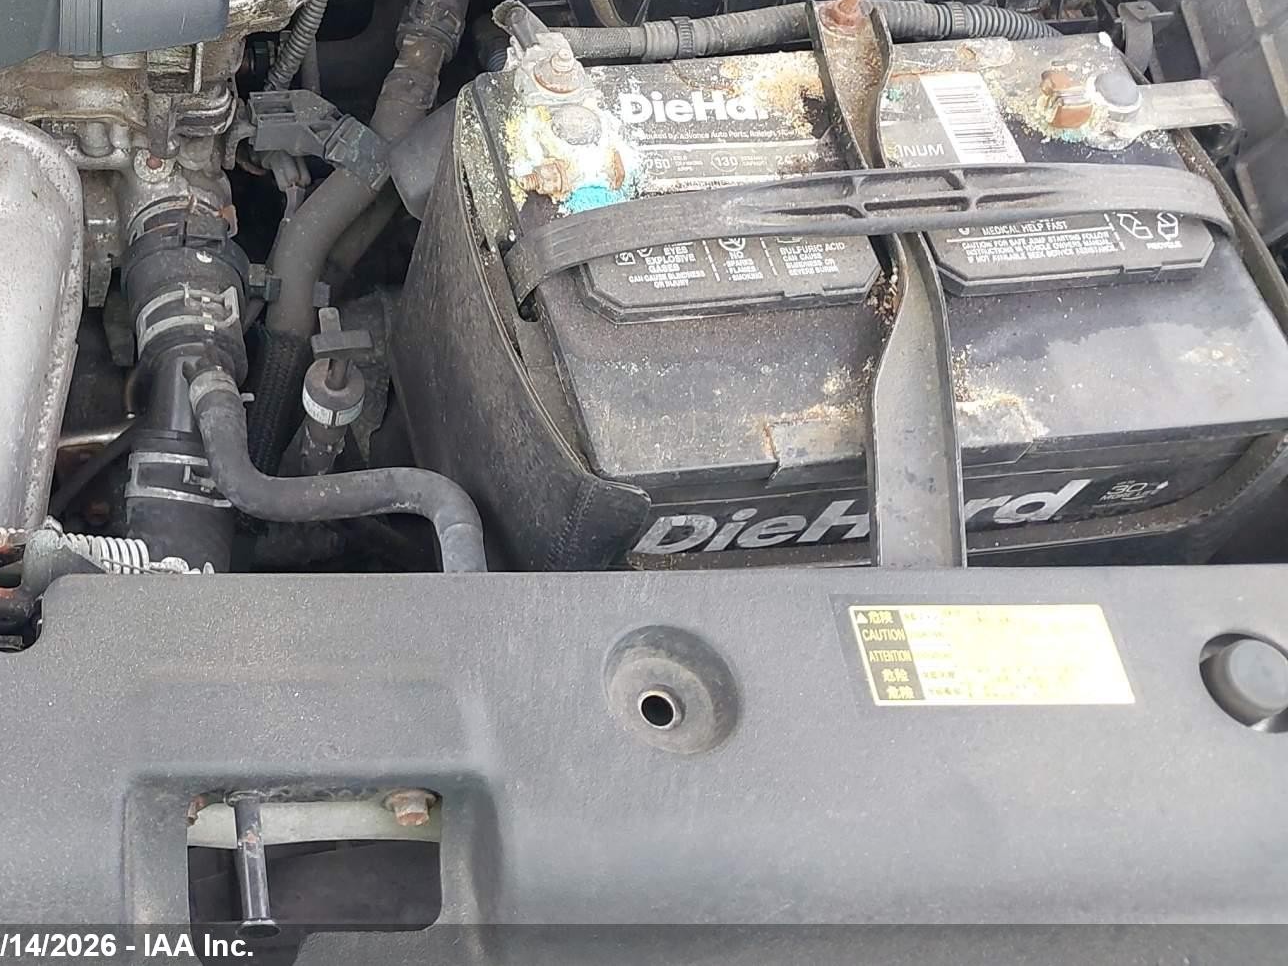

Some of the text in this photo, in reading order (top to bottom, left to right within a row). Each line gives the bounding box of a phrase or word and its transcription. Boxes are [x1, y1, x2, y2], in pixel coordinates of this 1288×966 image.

[981, 224, 1020, 236] MEDICAL
[1021, 222, 1044, 233] HELP
[1045, 220, 1068, 231] FAST
[663, 245, 689, 256] EYES
[779, 241, 846, 255] SULFURIC ACID
[645, 253, 697, 266] EXPLOSIVE
[729, 251, 744, 260] NO
[648, 263, 681, 274] GASES
[631, 480, 1092, 555] DieHrd
[861, 628, 906, 642] CAUTION
[868, 649, 913, 663] ATTENTION
